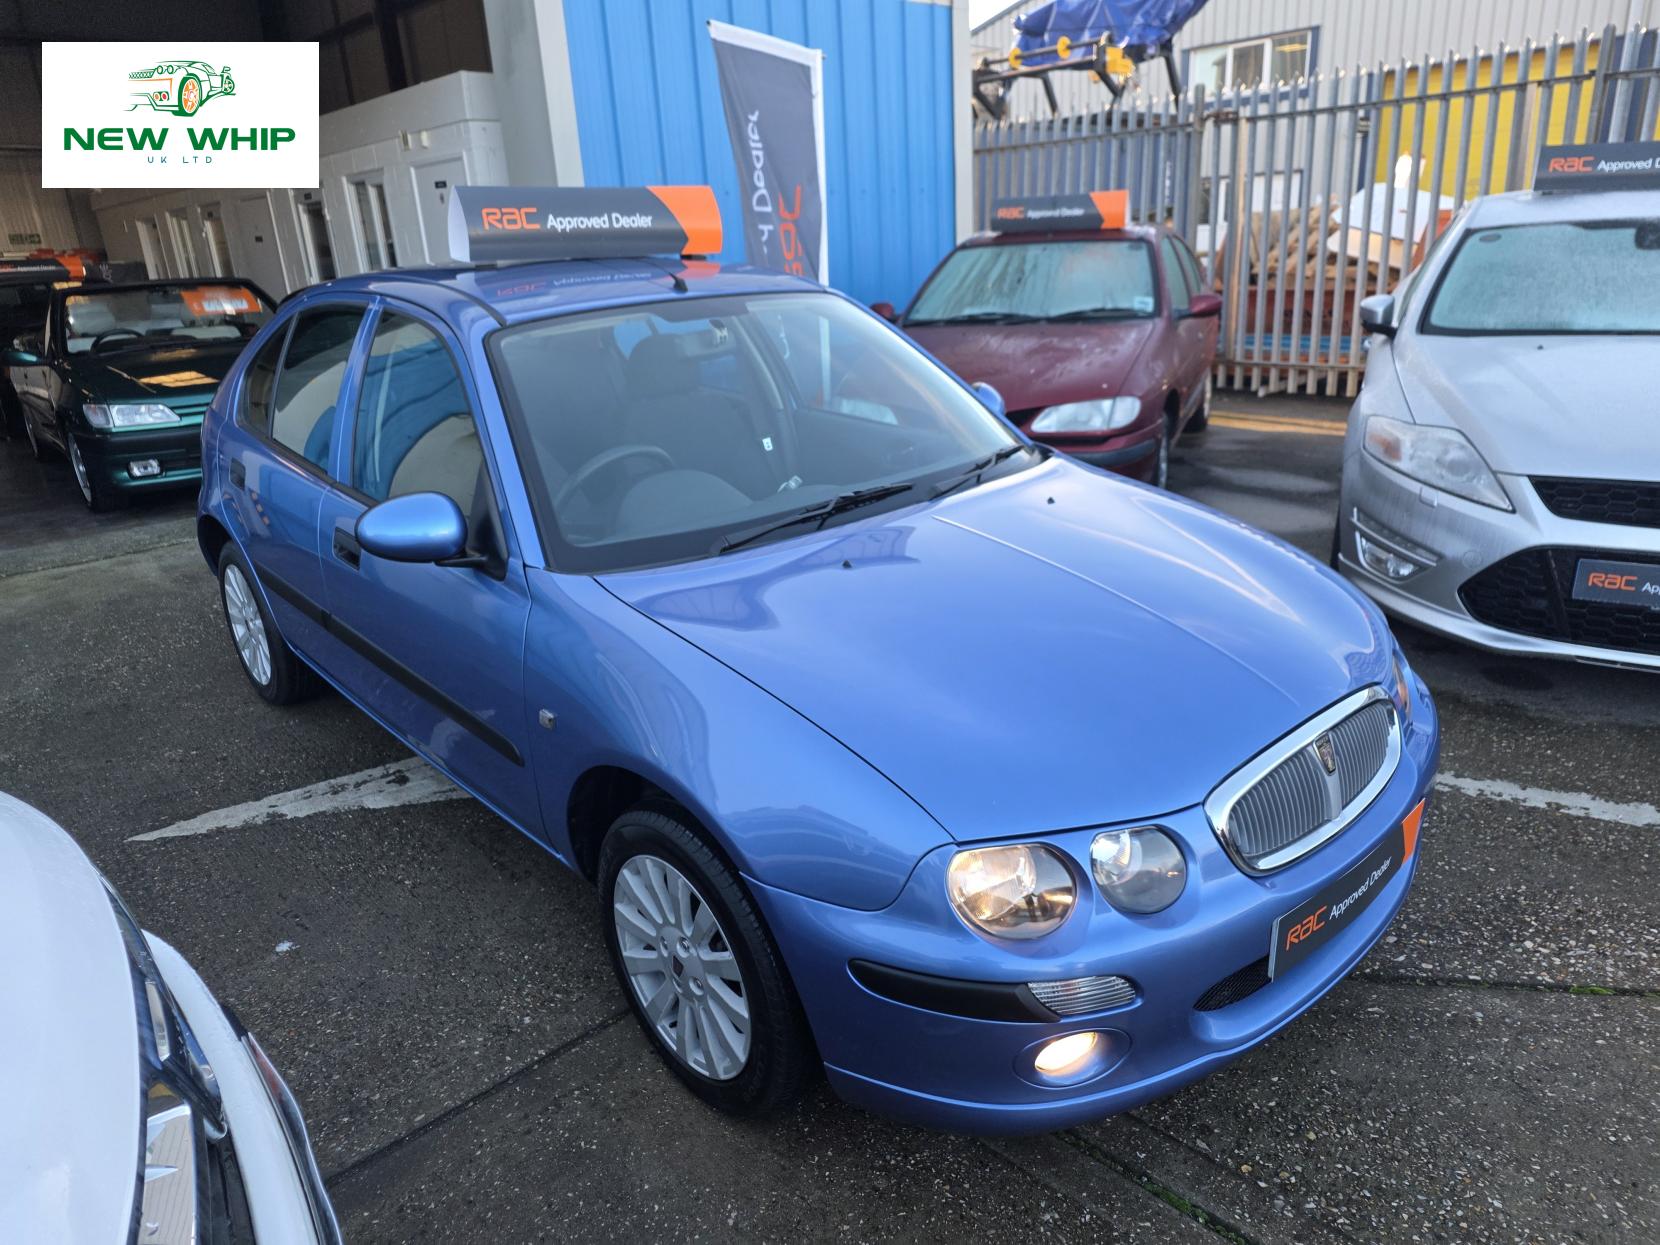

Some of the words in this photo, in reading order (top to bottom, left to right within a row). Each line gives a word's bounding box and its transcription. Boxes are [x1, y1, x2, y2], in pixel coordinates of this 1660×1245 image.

[1596, 158, 1653, 173] Approved
[547, 212, 609, 232] Approved
[611, 212, 653, 229] Dealer
[1329, 877, 1370, 920] Approved
[1370, 856, 1392, 886] Dealer
